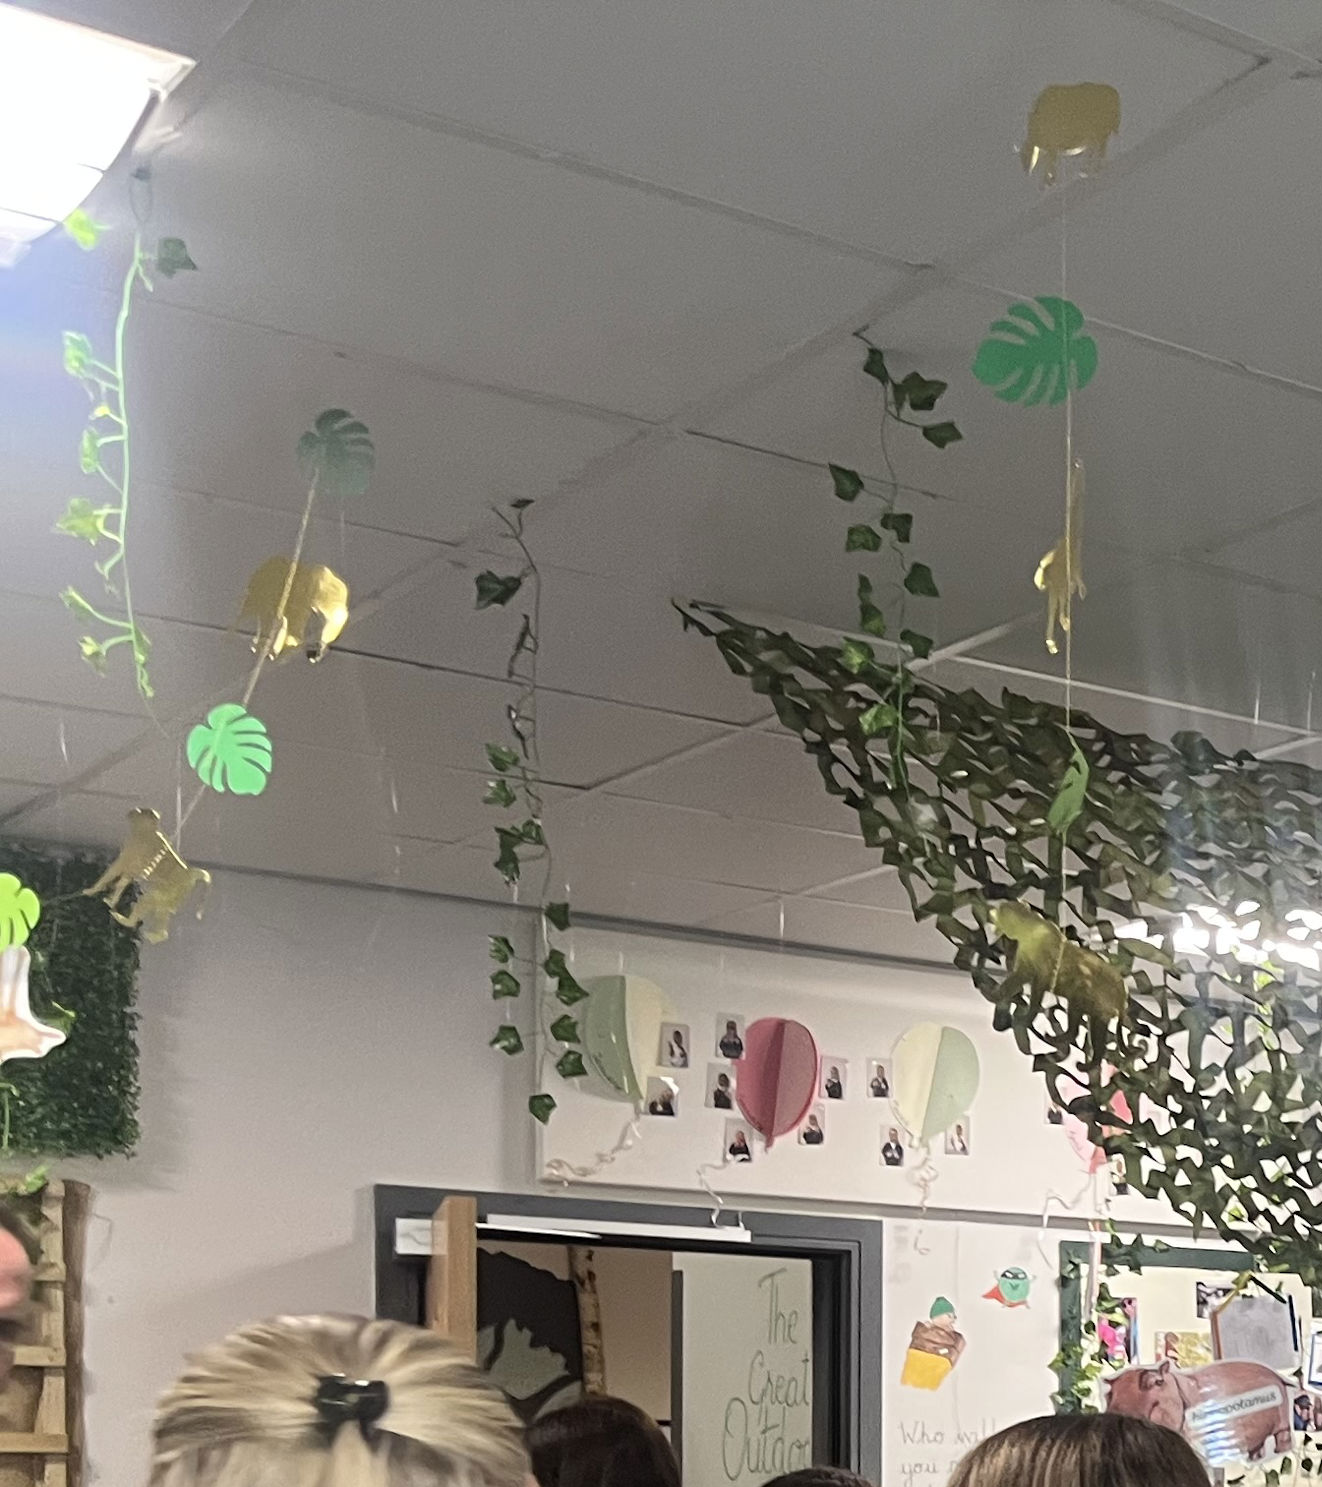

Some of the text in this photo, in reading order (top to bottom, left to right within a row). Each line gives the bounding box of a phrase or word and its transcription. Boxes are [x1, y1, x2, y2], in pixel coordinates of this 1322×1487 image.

[757, 1267, 799, 1345] The
[748, 1349, 810, 1424] Great
[896, 1419, 945, 1445] Who
